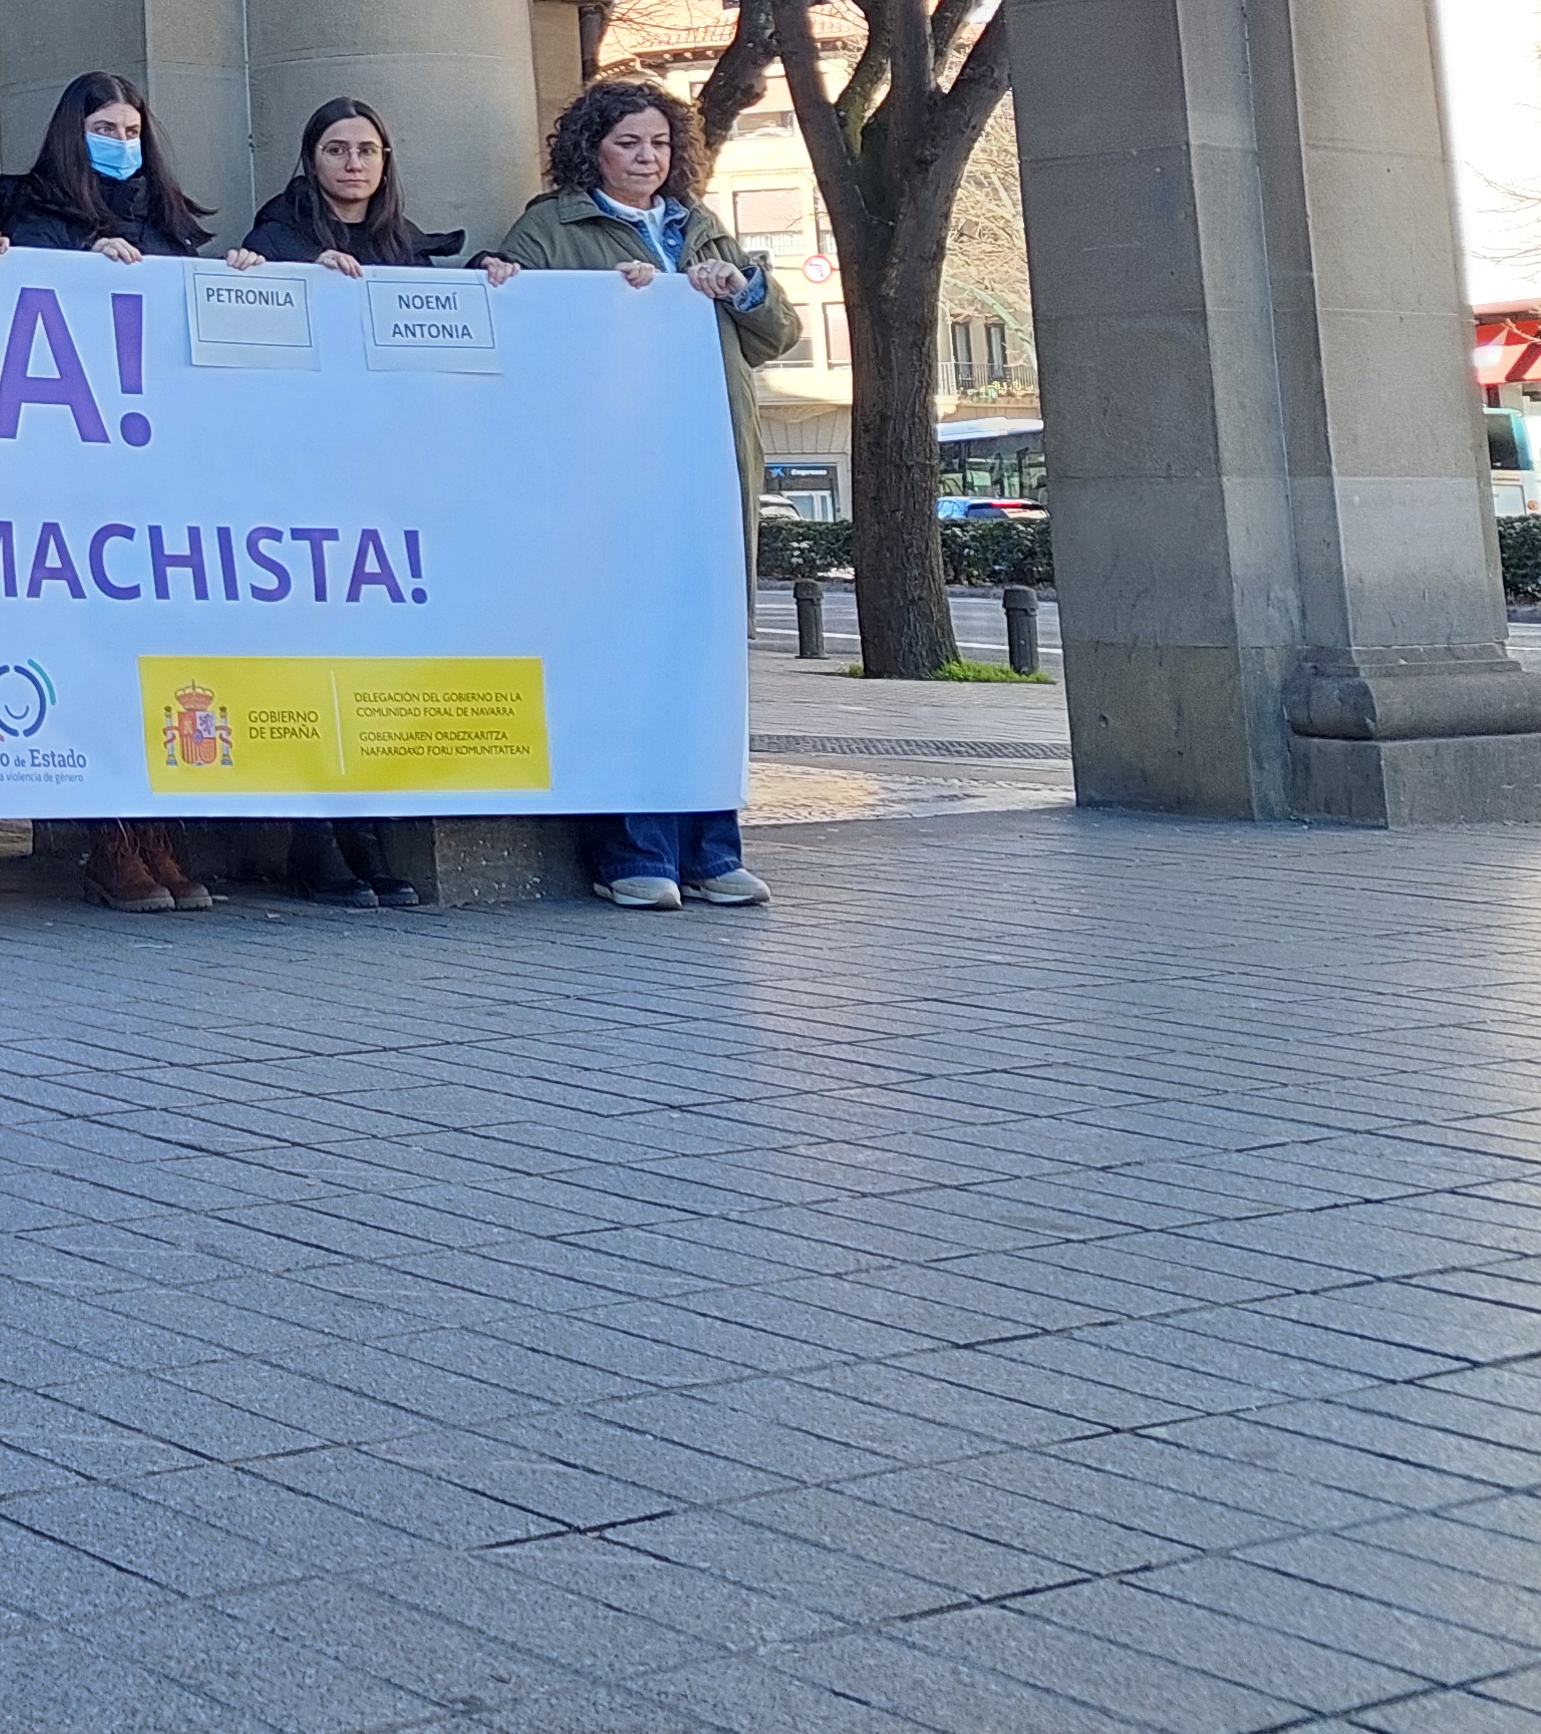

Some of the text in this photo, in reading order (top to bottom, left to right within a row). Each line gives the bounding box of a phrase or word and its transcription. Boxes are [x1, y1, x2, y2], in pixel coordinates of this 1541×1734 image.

[206, 287, 295, 308] PETRONILA
[398, 291, 458, 311] NOEMÍ
[392, 323, 473, 340] ANTONIA
[354, 691, 522, 703] DELEGACIÓN DEL GOBIERNO EN LA
[248, 710, 319, 723] GOBIERNO
[356, 707, 515, 717] COMUNIDAD FORAL DE NAVARRA
[249, 723, 320, 739] DE ESPAÑA
[427, 746, 453, 755] FORU
[455, 745, 530, 755] KOMUNITATEAN
[14, 755, 26, 767] de
[28, 748, 87, 768] Estado
[6, 771, 42, 782] violencia
[43, 771, 54, 782] de
